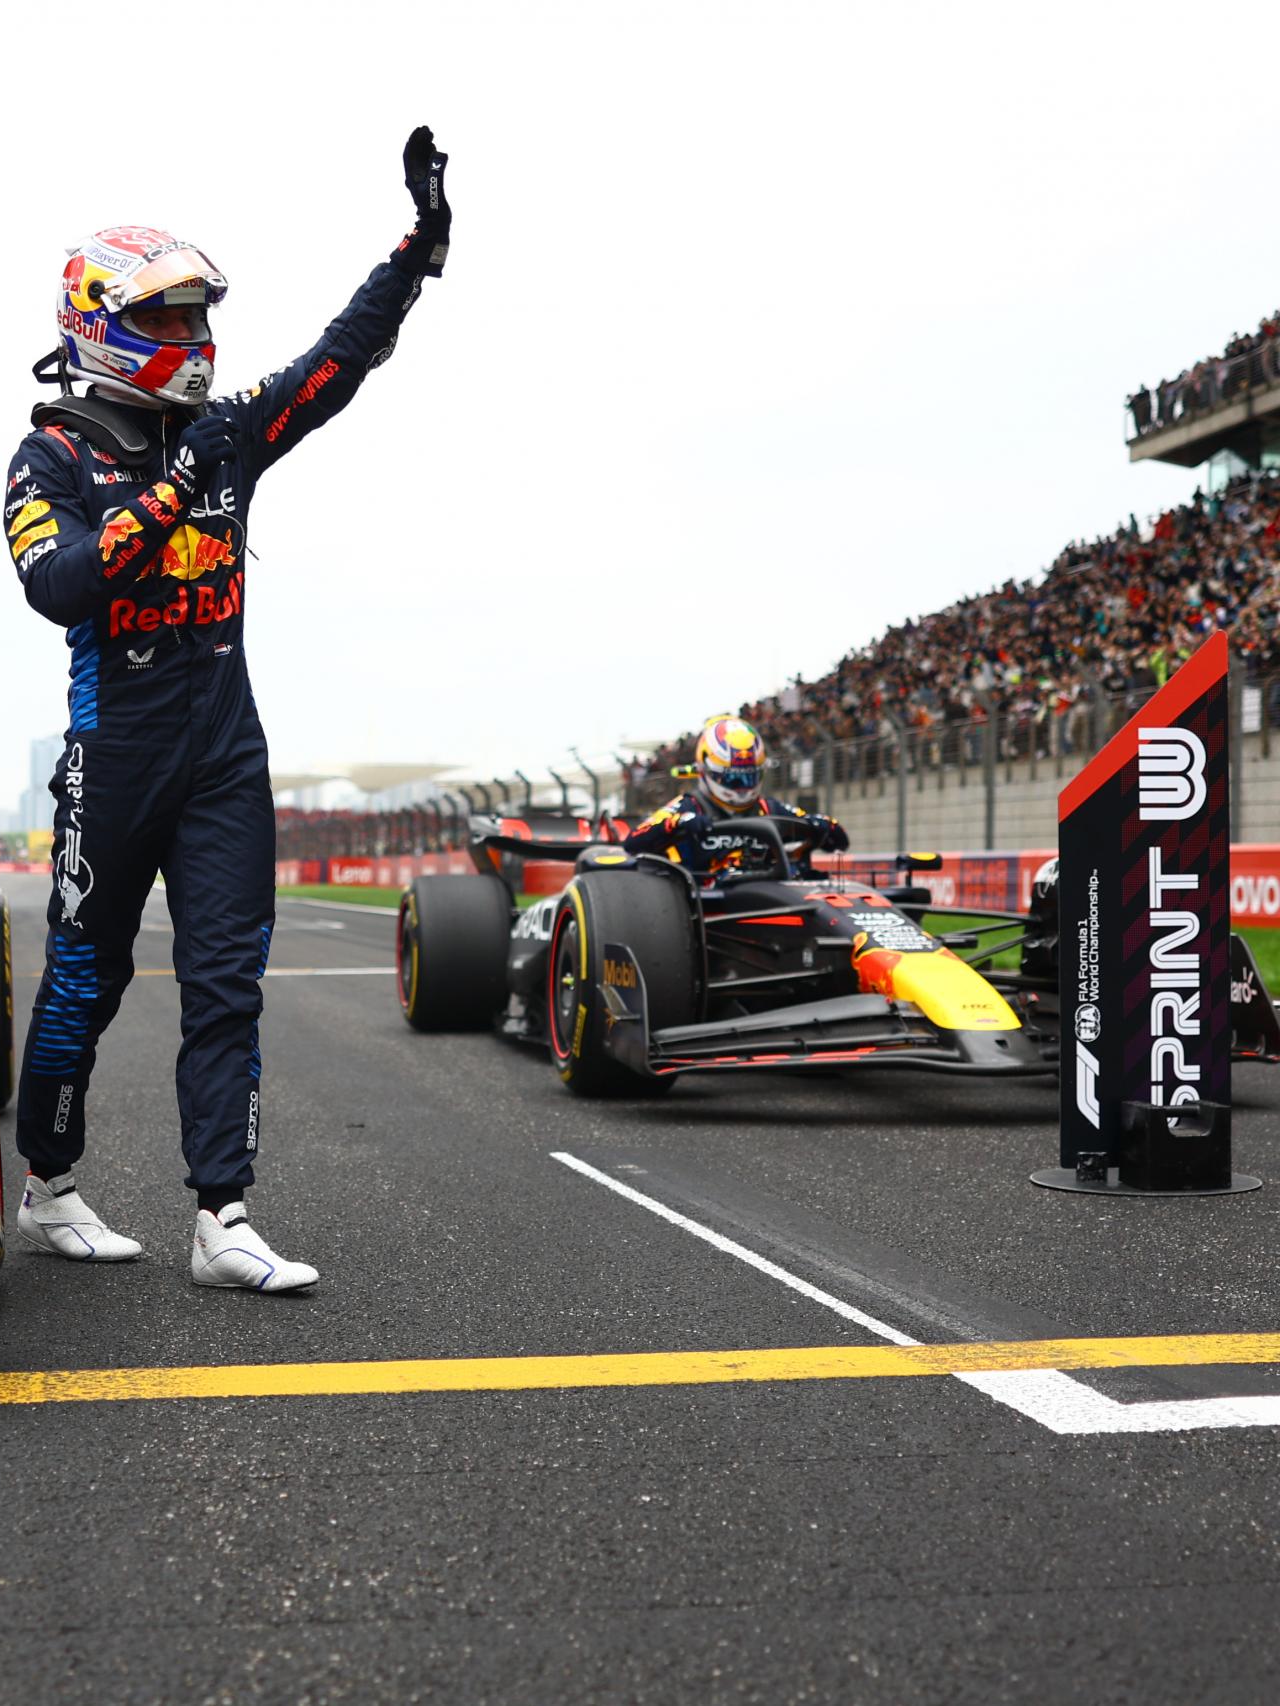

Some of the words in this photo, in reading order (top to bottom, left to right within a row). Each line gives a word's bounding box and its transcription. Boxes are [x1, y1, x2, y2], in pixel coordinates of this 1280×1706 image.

[57, 306, 72, 330] ed
[72, 310, 108, 345] Bull
[185, 374, 208, 391] EA
[92, 470, 132, 484] Mobil
[148, 502, 176, 527] Bull
[19, 538, 58, 572] VISA
[103, 554, 126, 579] Red
[123, 537, 145, 561] Bull
[109, 586, 189, 638] Red
[1078, 918, 1089, 926] 1
[1078, 928, 1089, 979] Formula
[1078, 981, 1089, 1002] FIA
[1089, 965, 1099, 1002] World
[54, 1084, 74, 1134] sparco
[246, 1090, 259, 1151] sparco
